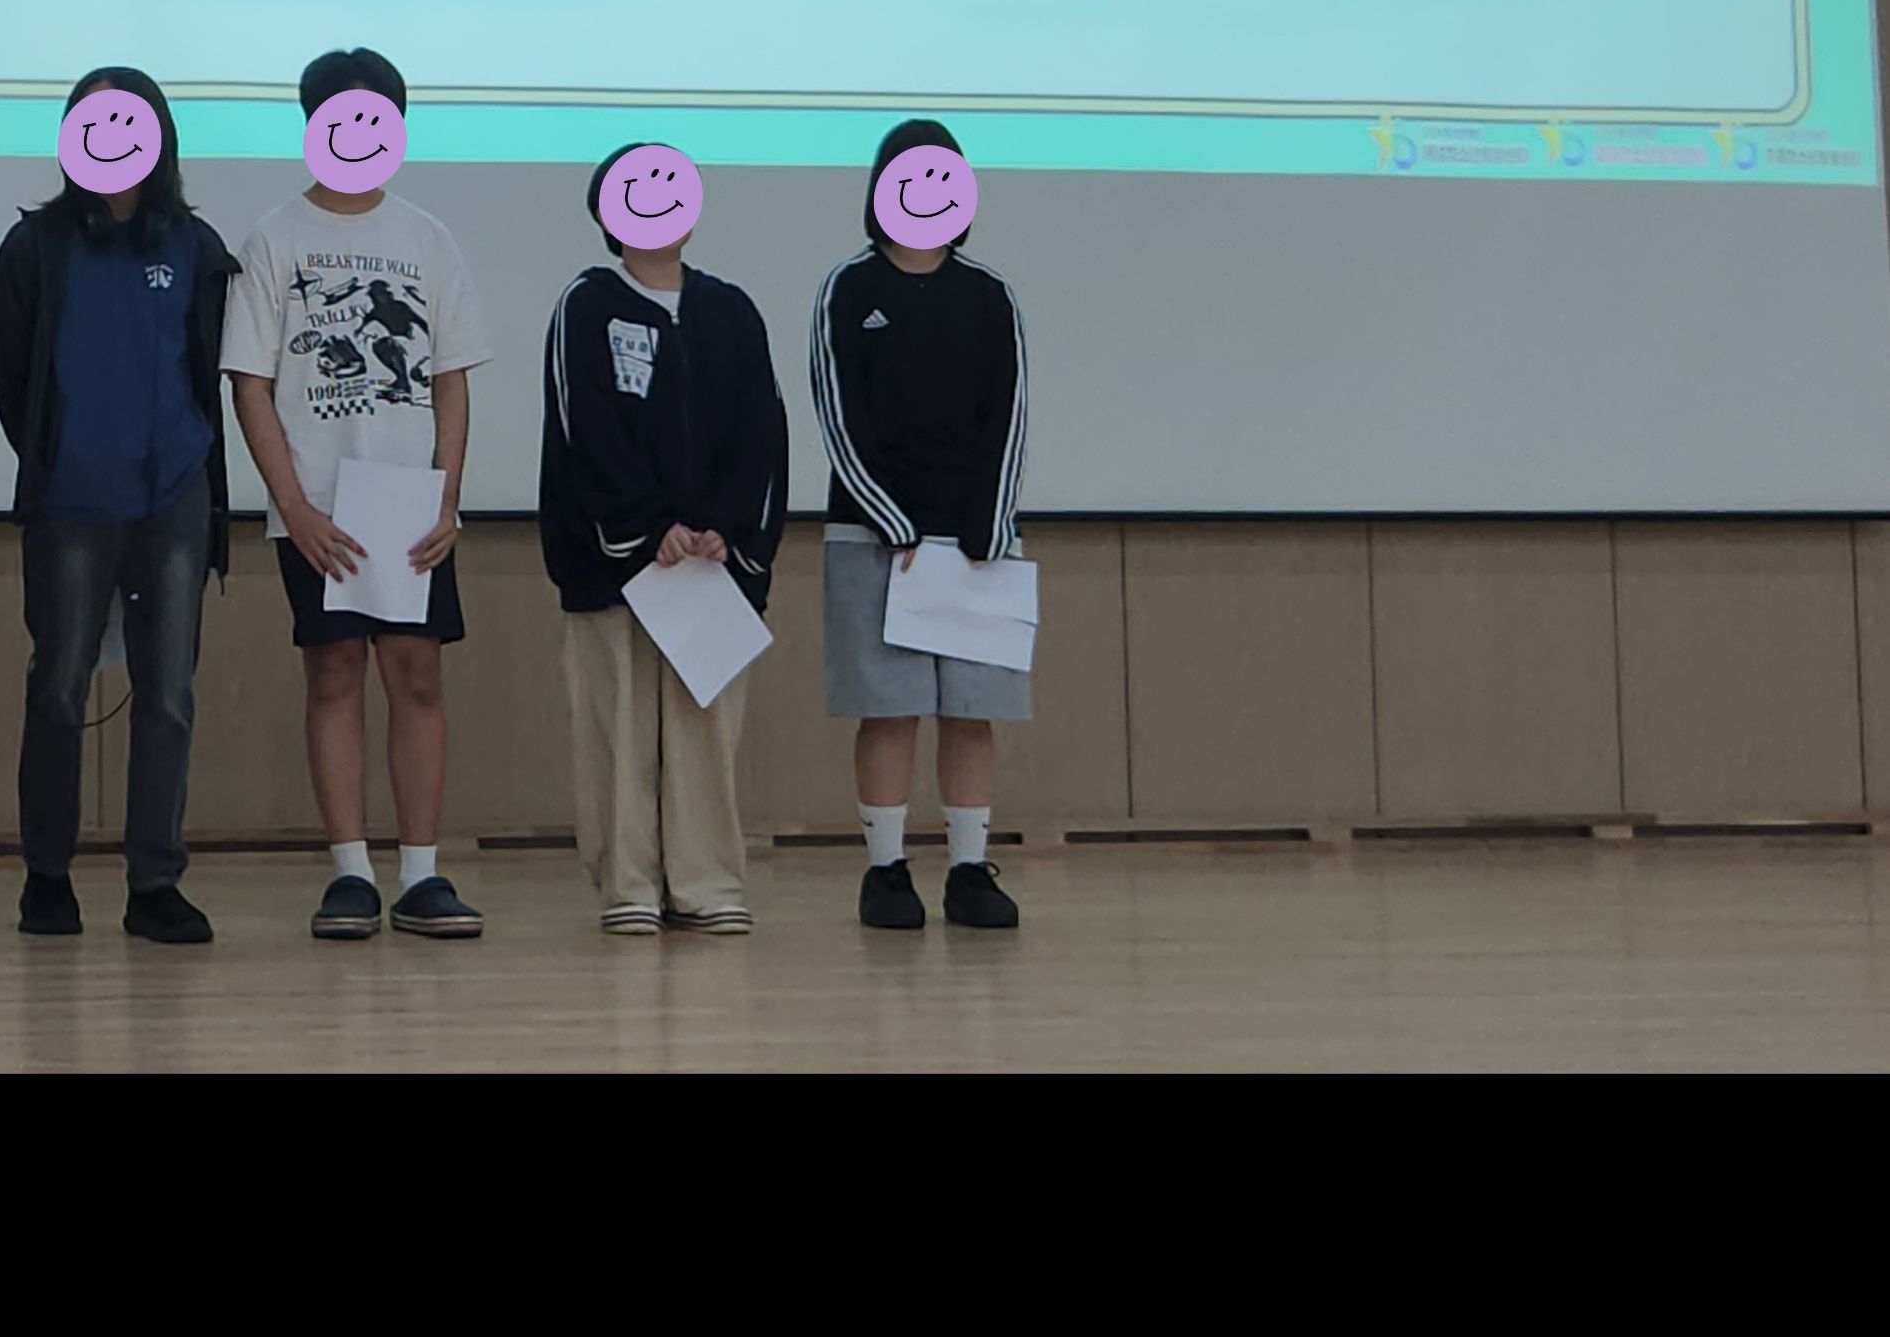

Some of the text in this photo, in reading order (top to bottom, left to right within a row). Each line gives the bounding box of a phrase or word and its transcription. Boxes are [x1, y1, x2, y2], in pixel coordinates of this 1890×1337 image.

[306, 253, 422, 282] BREAK THE WALL
